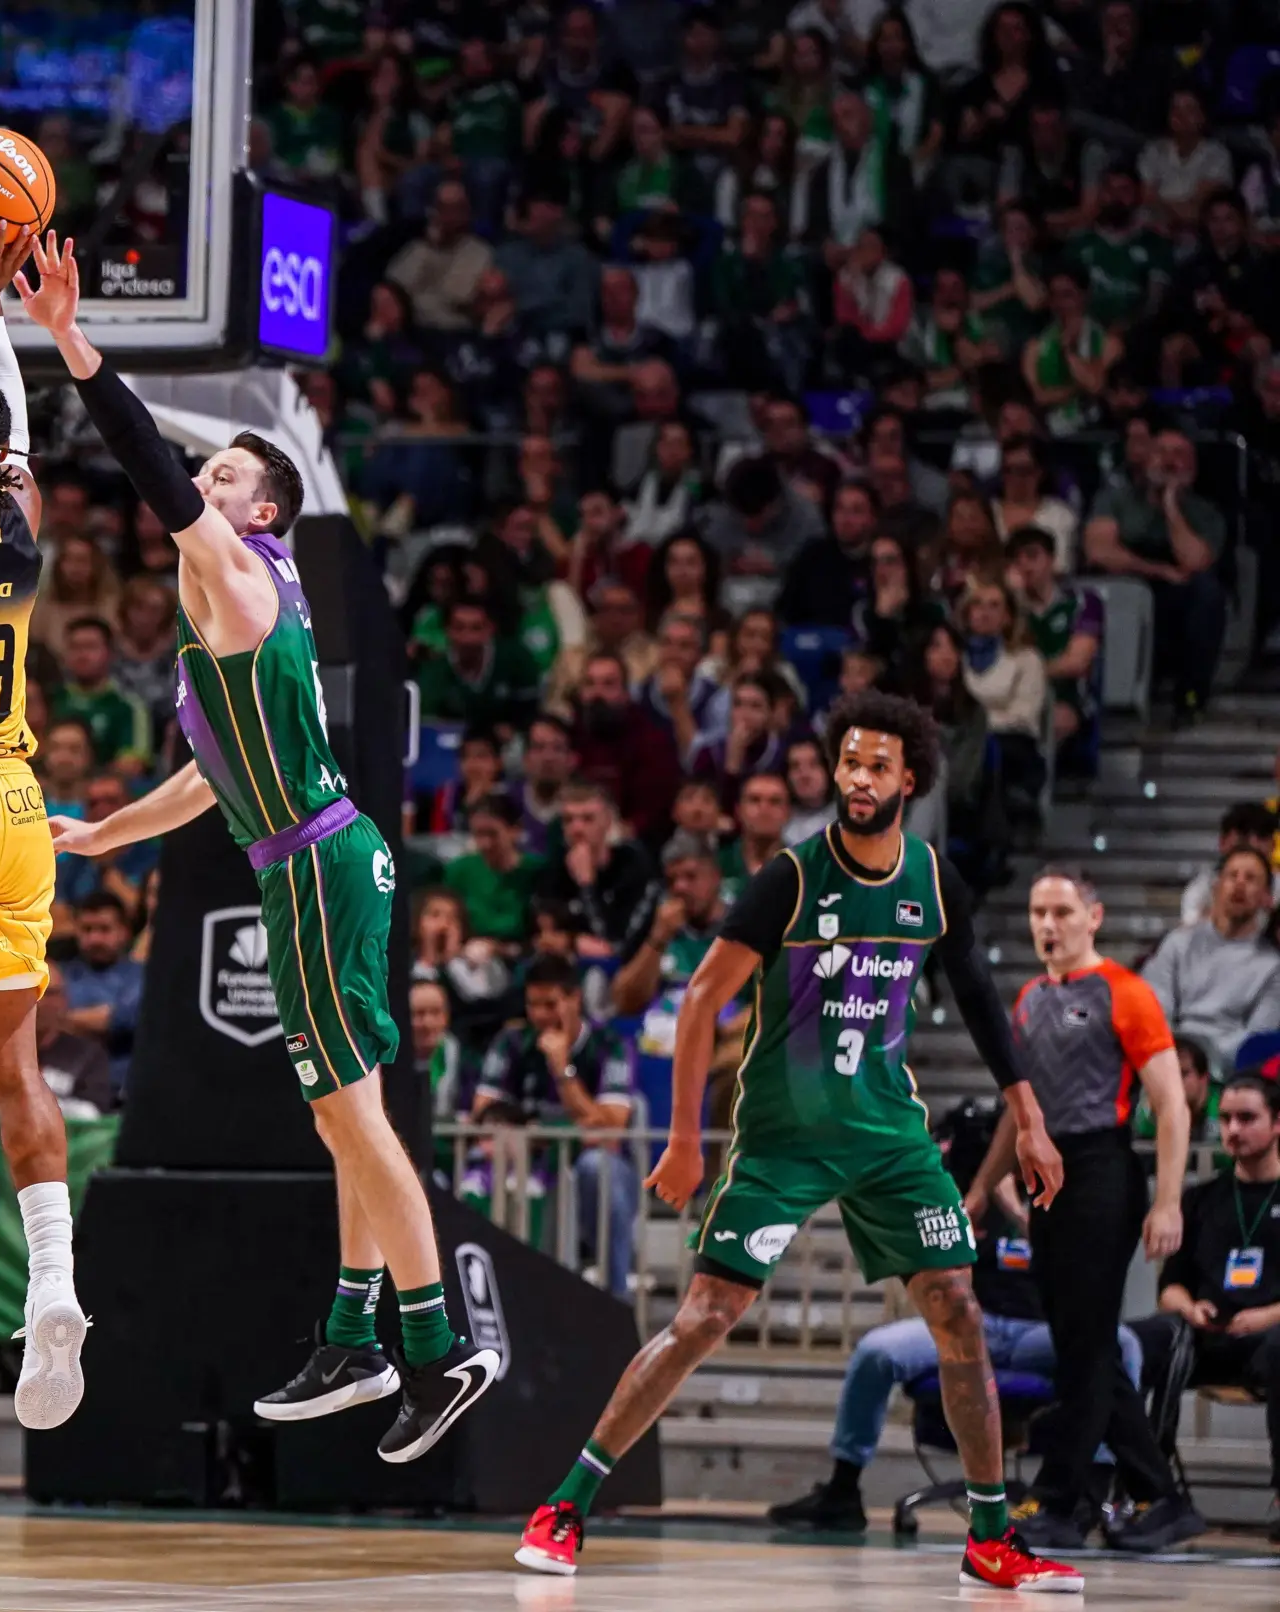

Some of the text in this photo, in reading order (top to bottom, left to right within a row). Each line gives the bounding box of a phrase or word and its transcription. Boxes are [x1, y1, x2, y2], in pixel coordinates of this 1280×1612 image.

[262, 246, 323, 321] esa
[11, 812, 36, 826] Canary
[288, 1041, 303, 1050] acb
[833, 1028, 865, 1076] 3
[920, 1227, 962, 1251] laga
